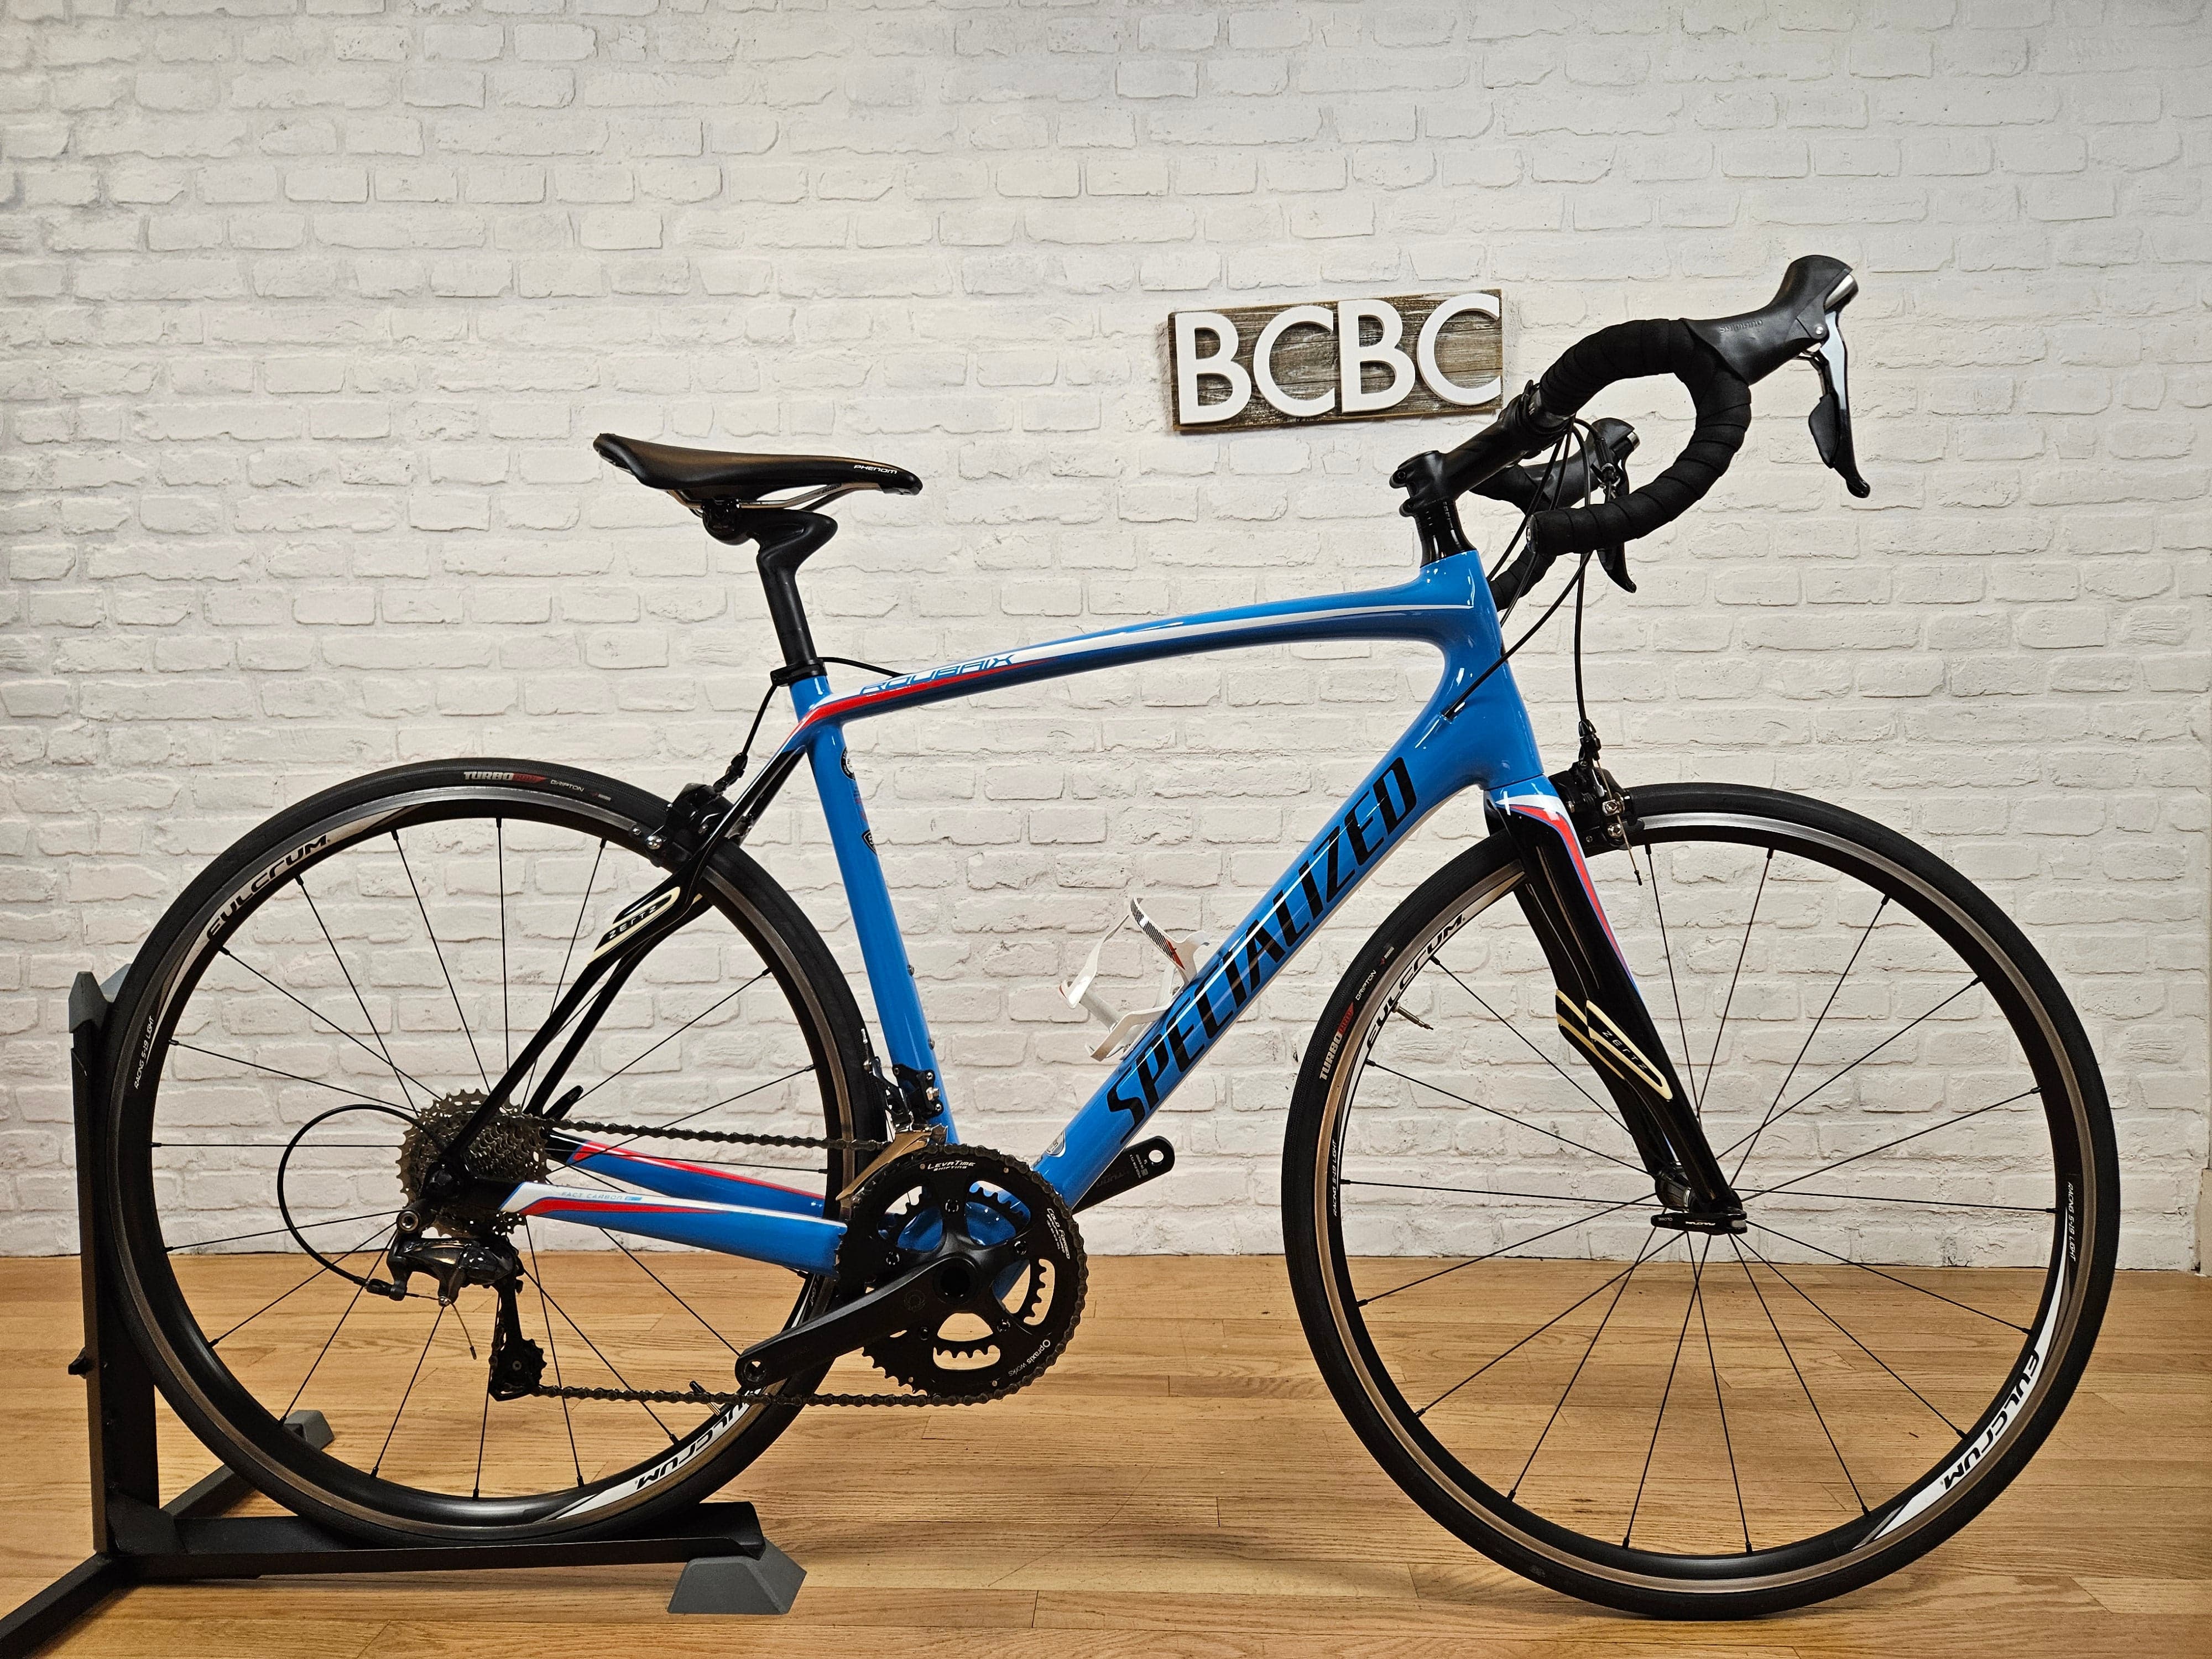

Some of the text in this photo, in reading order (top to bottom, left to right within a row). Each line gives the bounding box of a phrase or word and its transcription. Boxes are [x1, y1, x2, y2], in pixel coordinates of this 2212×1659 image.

[1175, 293, 1501, 424] BCBC
[853, 465, 898, 474] PHENOM
[859, 654, 1015, 695] ROUBAIX
[463, 771, 514, 780] TURBO
[550, 779, 585, 792] GRIPTON
[206, 834, 327, 940] FULCRUM
[1106, 757, 1417, 1143] SPECIALIZED
[1355, 969, 1377, 1001] GRIPTON
[1366, 913, 1463, 1050] FULCRUM
[134, 1059, 145, 1089] RACING
[145, 1015, 154, 1040] LIGHT
[1319, 1031, 1343, 1081] TURBO
[1047, 1208, 1061, 1228] COLD
[1008, 1344, 1045, 1376] praxis works
[1943, 1348, 2040, 1490] FULCRUM
